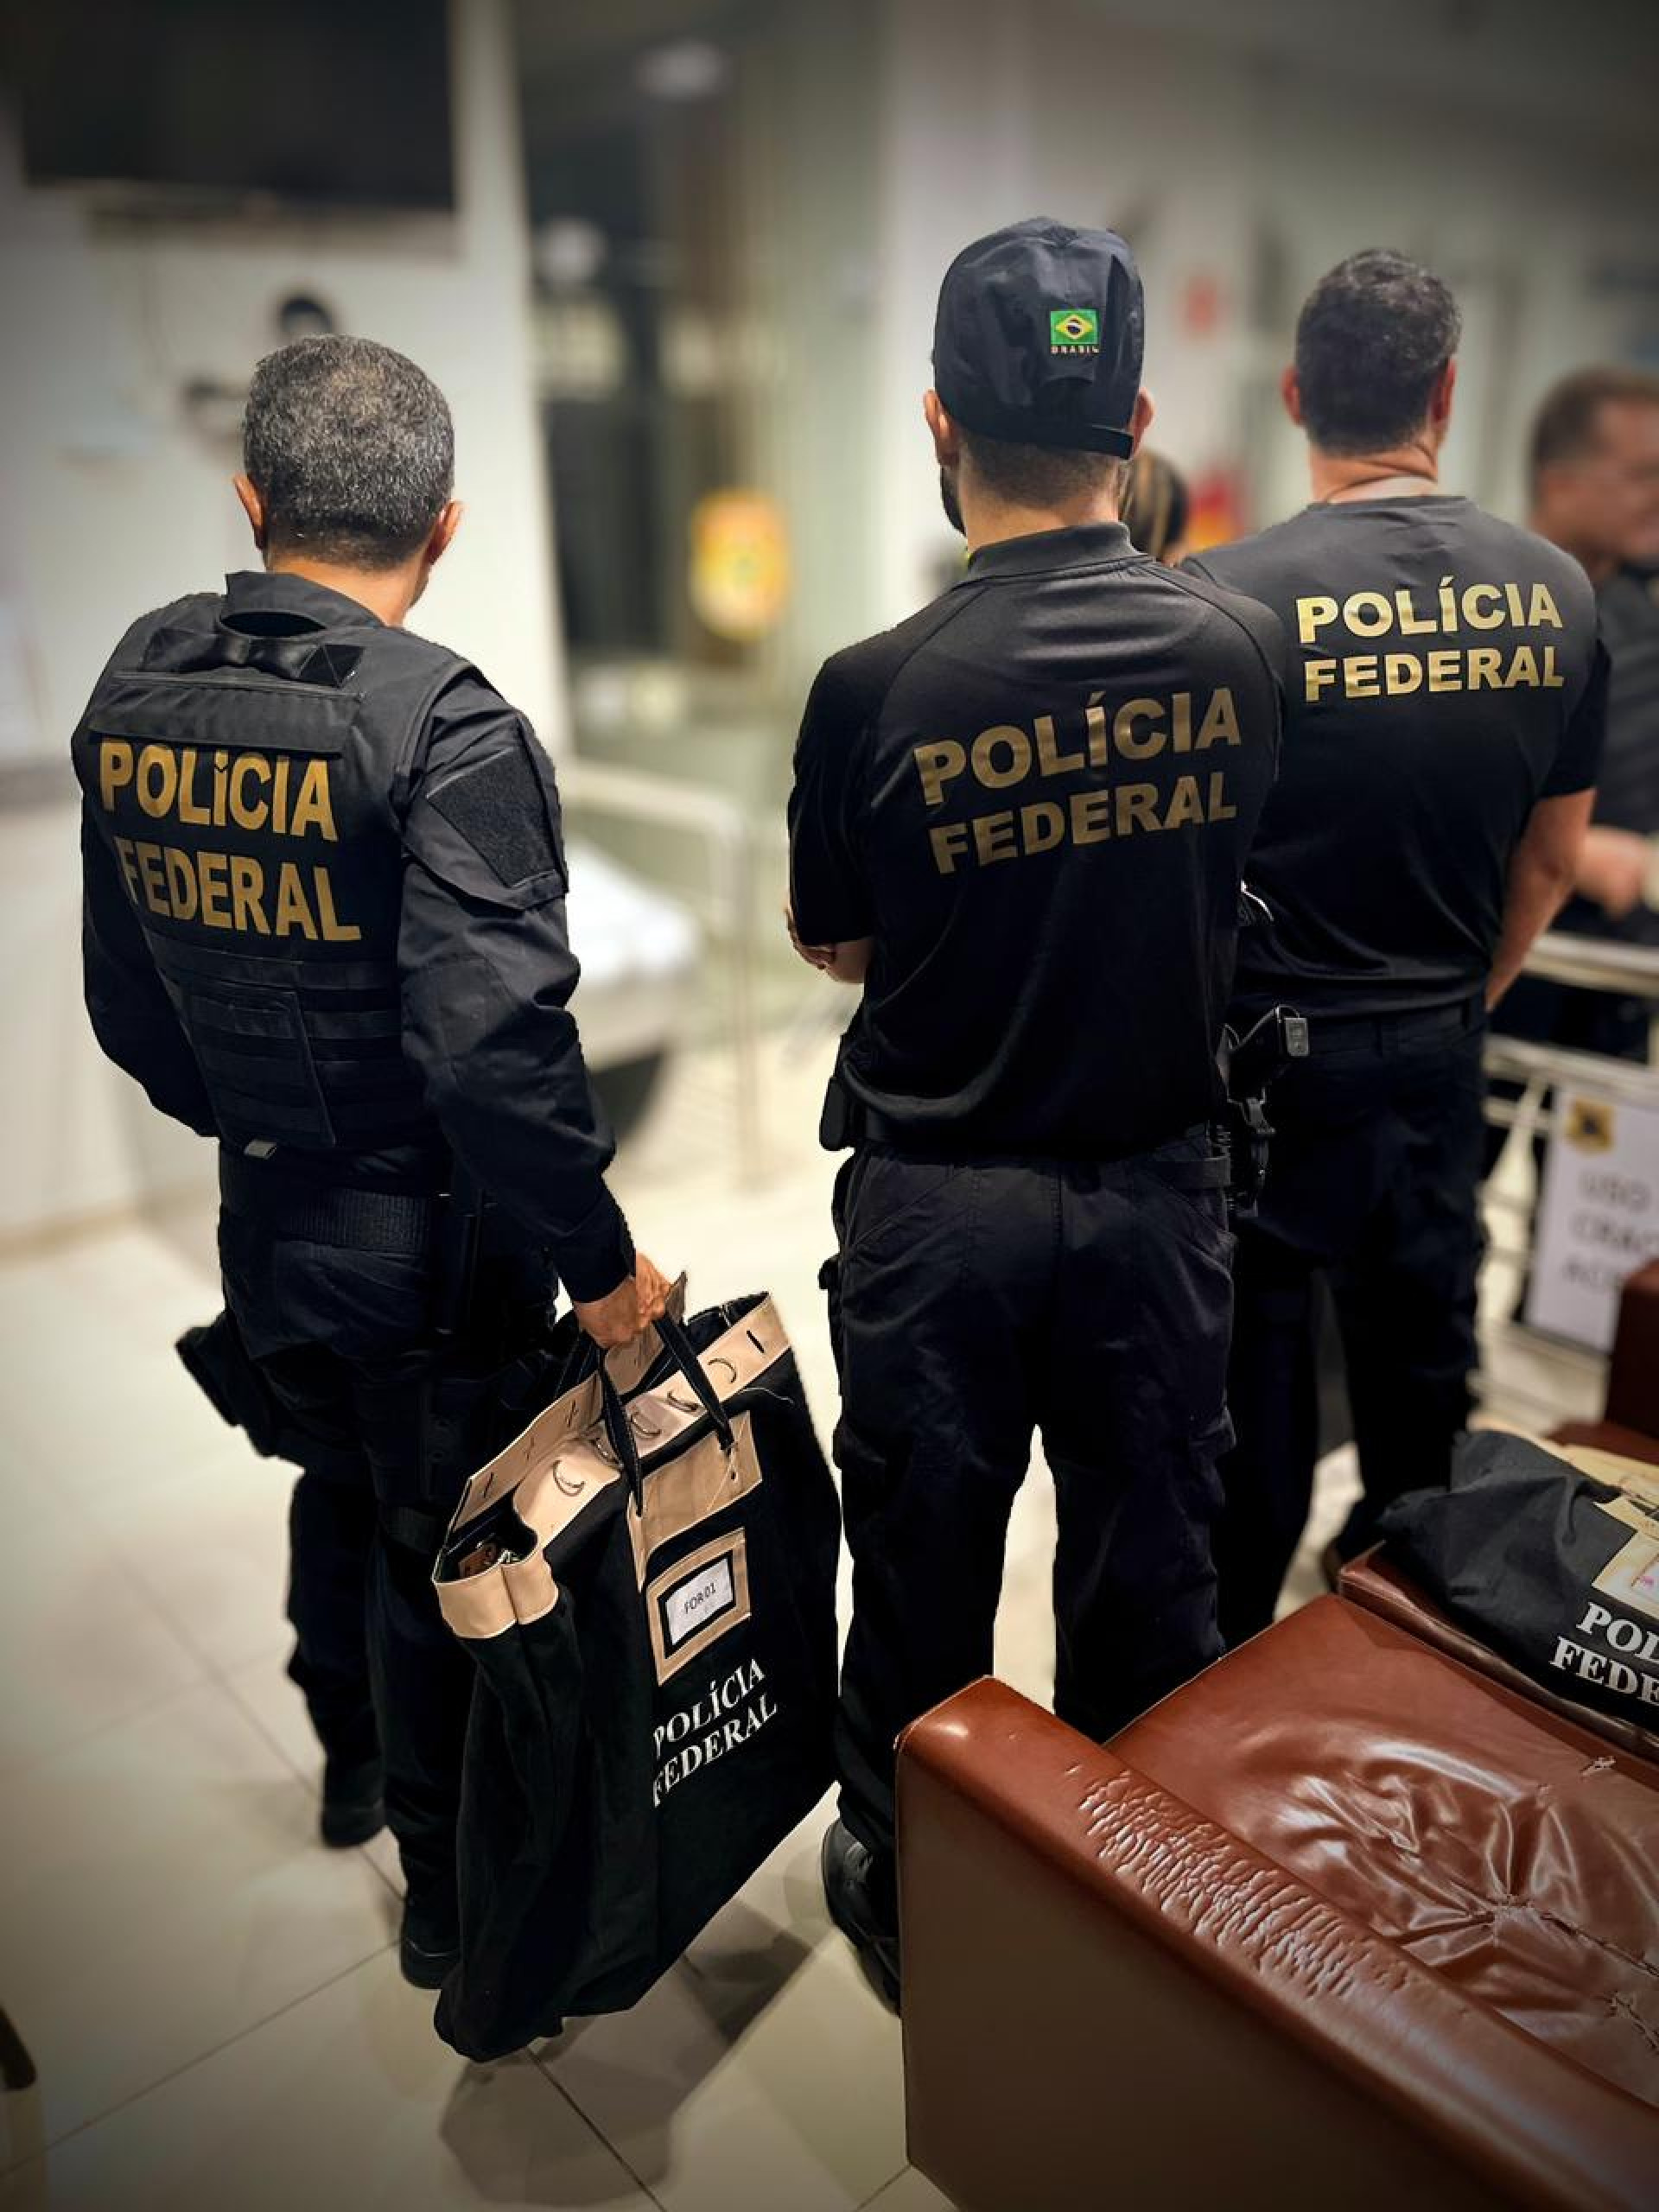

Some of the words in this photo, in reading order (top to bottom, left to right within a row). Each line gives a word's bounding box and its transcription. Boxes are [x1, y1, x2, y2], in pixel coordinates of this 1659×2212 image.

[1051, 346, 1099, 354] BRASIL
[1297, 575, 1563, 644] POLÍCIA
[1305, 646, 1564, 702] FEDERAL
[99, 739, 338, 842] POLÍCIA
[914, 688, 1242, 805] POLÍCIA
[929, 772, 1236, 874] FEDERAL
[113, 836, 361, 941] FEDERAL
[1550, 1637, 1659, 1707] FEDE
[1576, 1601, 1659, 1662] POL
[653, 1658, 766, 1759] POLÍCIA
[653, 1693, 778, 1808] FEDERAL
